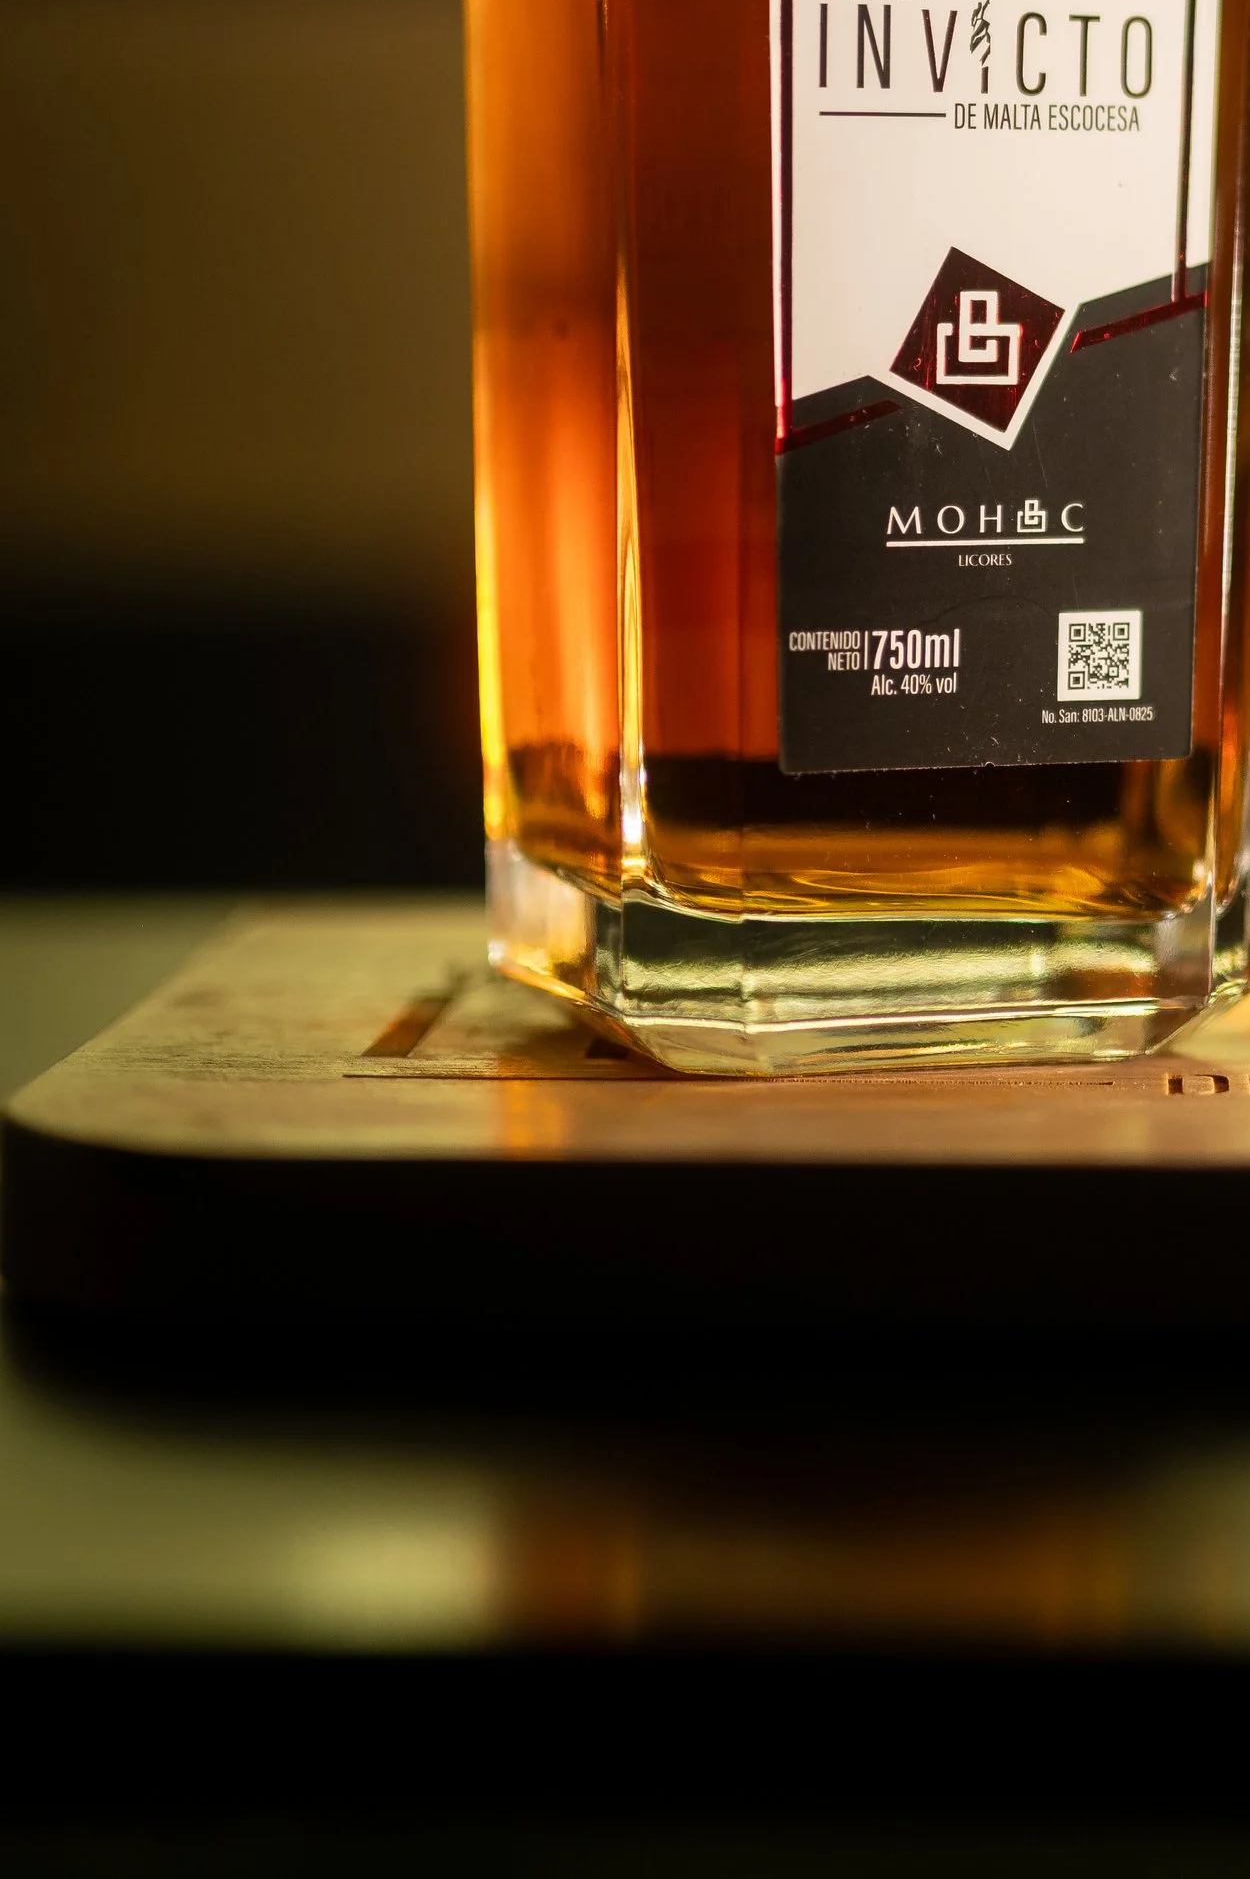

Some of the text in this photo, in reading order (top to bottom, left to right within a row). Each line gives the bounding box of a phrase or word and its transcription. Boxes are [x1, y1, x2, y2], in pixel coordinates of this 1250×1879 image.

[818, 1, 1154, 100] INVICTO
[954, 102, 1141, 133] DE MALTA ESCOCESA
[958, 553, 1013, 568] LICORES
[788, 630, 861, 652] CONTENIDO
[871, 627, 961, 671] 750ml
[827, 651, 860, 671] NETO
[870, 671, 958, 696] Alc. 40% vol
[1041, 709, 1057, 724] No.
[1058, 708, 1080, 724] San:
